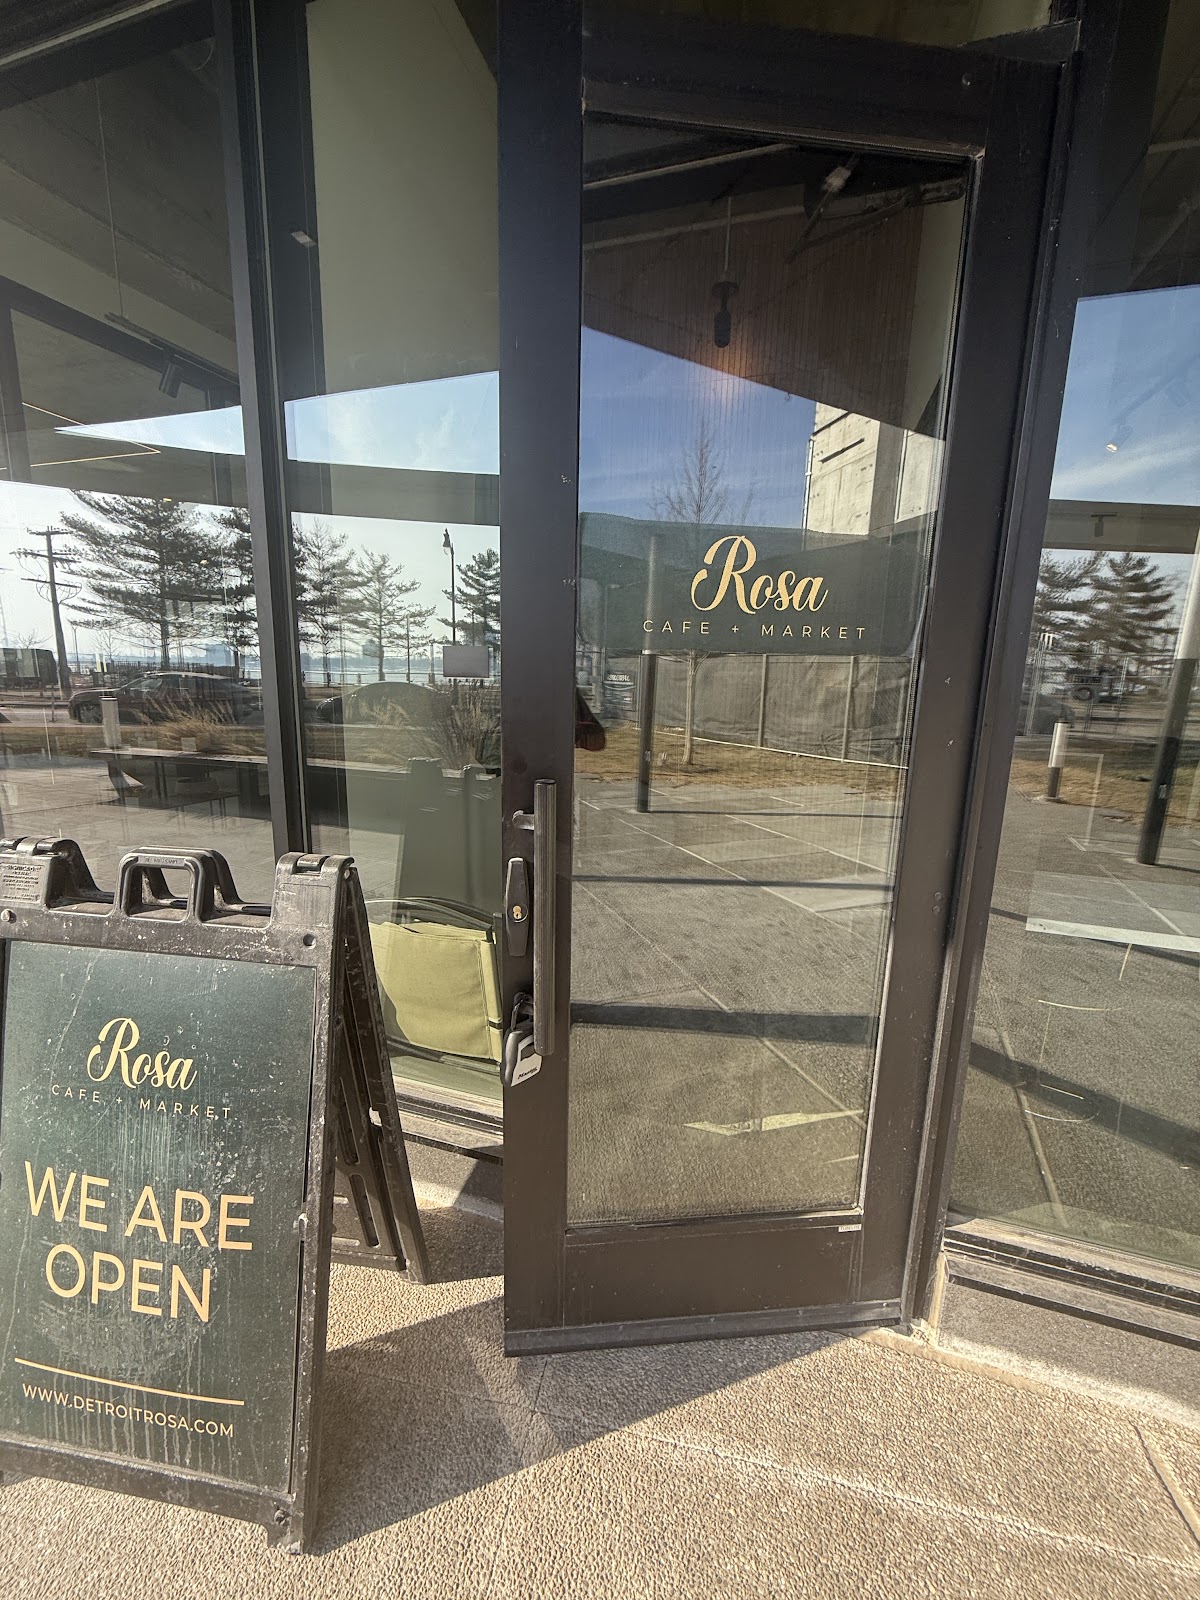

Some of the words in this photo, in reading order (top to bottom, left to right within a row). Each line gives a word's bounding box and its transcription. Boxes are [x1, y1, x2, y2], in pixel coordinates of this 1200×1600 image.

[690, 534, 829, 615] Rosa
[642, 619, 710, 635] CAFE
[731, 624, 740, 634] +
[761, 623, 866, 640] MARKET
[87, 1018, 198, 1090] Rosa
[51, 1083, 101, 1104] CAFE
[115, 1096, 123, 1105] +
[138, 1097, 232, 1120] MARKET
[25, 1161, 110, 1233] WE
[124, 1185, 254, 1251] ARE
[45, 1243, 212, 1323] OPEN
[22, 1383, 234, 1438] WWW.DETROITROSA.COM
